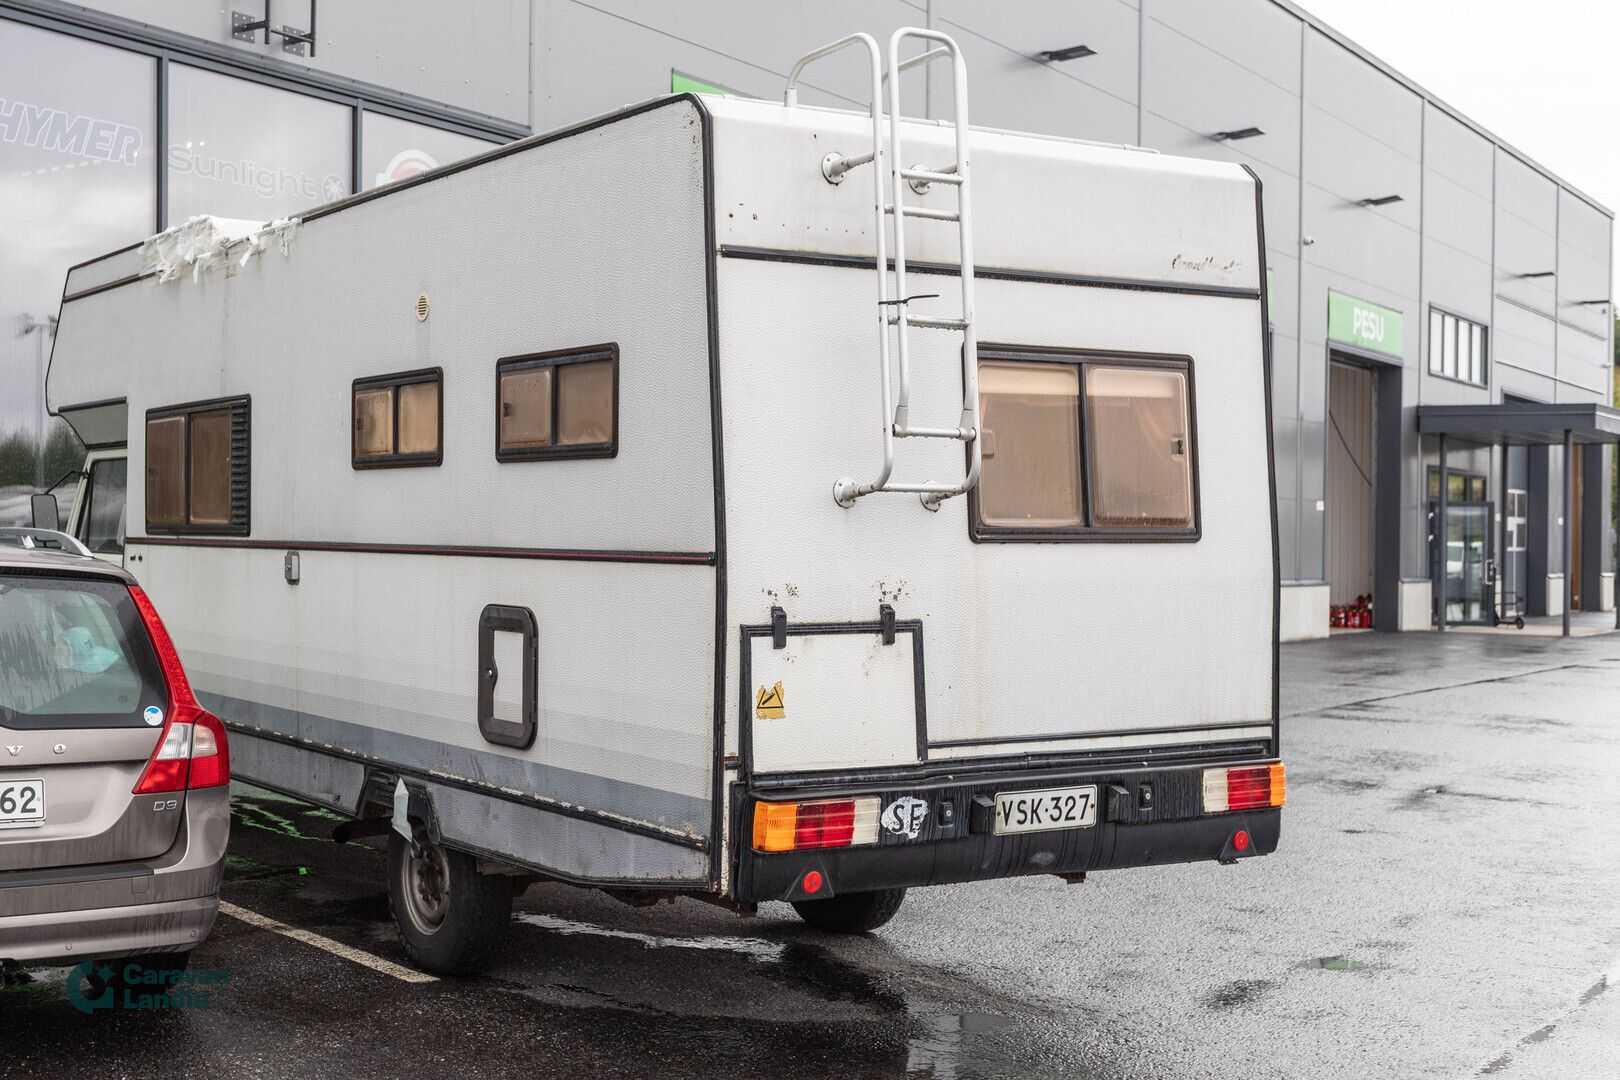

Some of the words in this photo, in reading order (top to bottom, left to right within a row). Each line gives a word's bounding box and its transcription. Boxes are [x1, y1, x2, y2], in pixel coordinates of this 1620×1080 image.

[0, 98, 143, 167] HYMER
[167, 144, 318, 200] Sunlight
[1353, 306, 1385, 343] PESU
[0, 786, 37, 815] 62
[891, 803, 923, 833] SF
